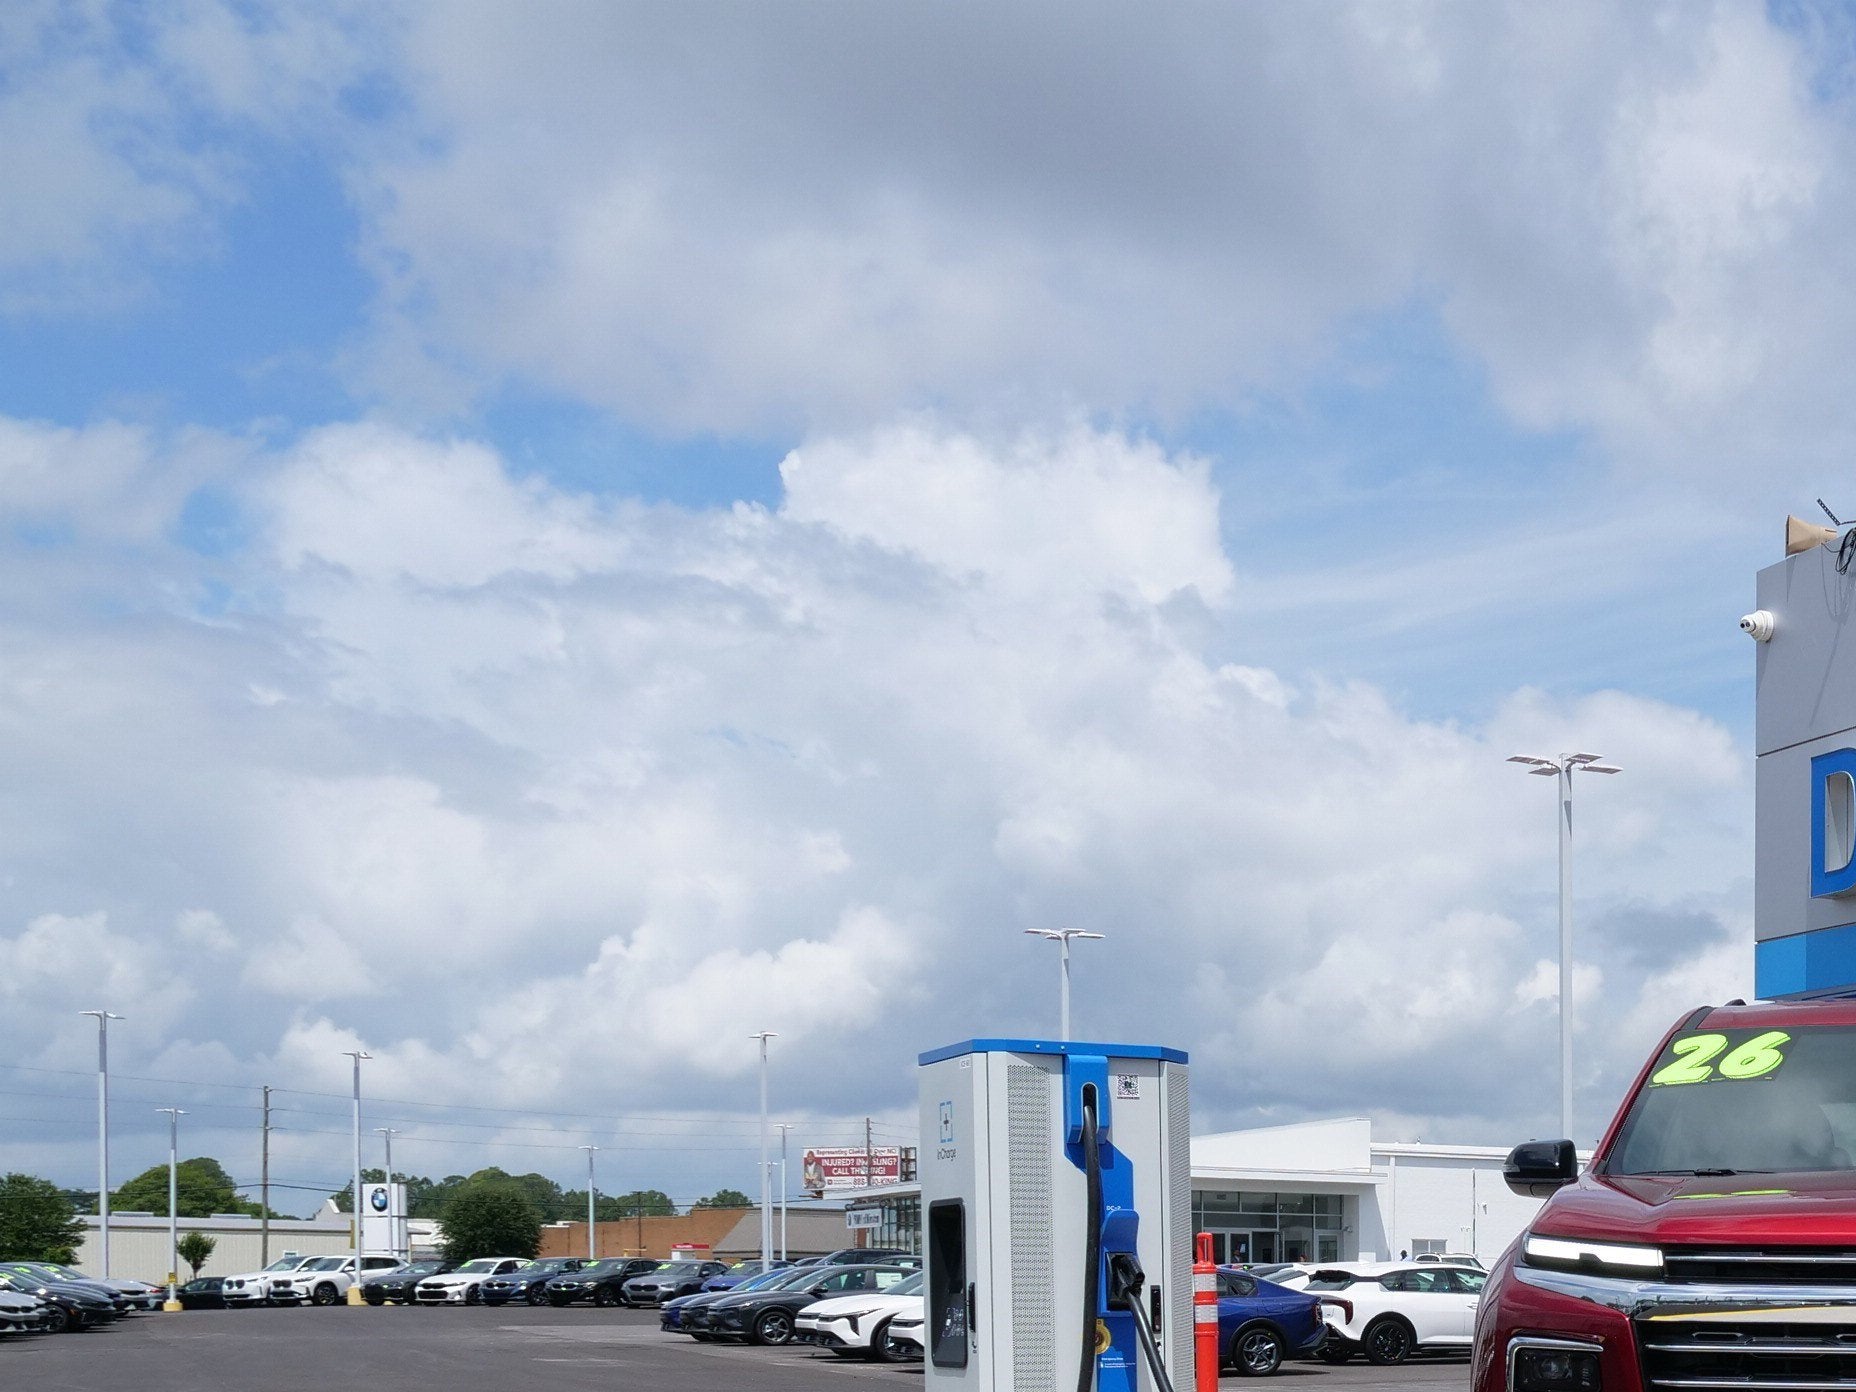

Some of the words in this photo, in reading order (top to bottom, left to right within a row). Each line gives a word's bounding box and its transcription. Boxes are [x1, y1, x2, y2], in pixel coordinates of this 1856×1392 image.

[1652, 1031, 1792, 1085] 26
[821, 1158, 855, 1166] INJURED?
[832, 1167, 849, 1175] CALL
